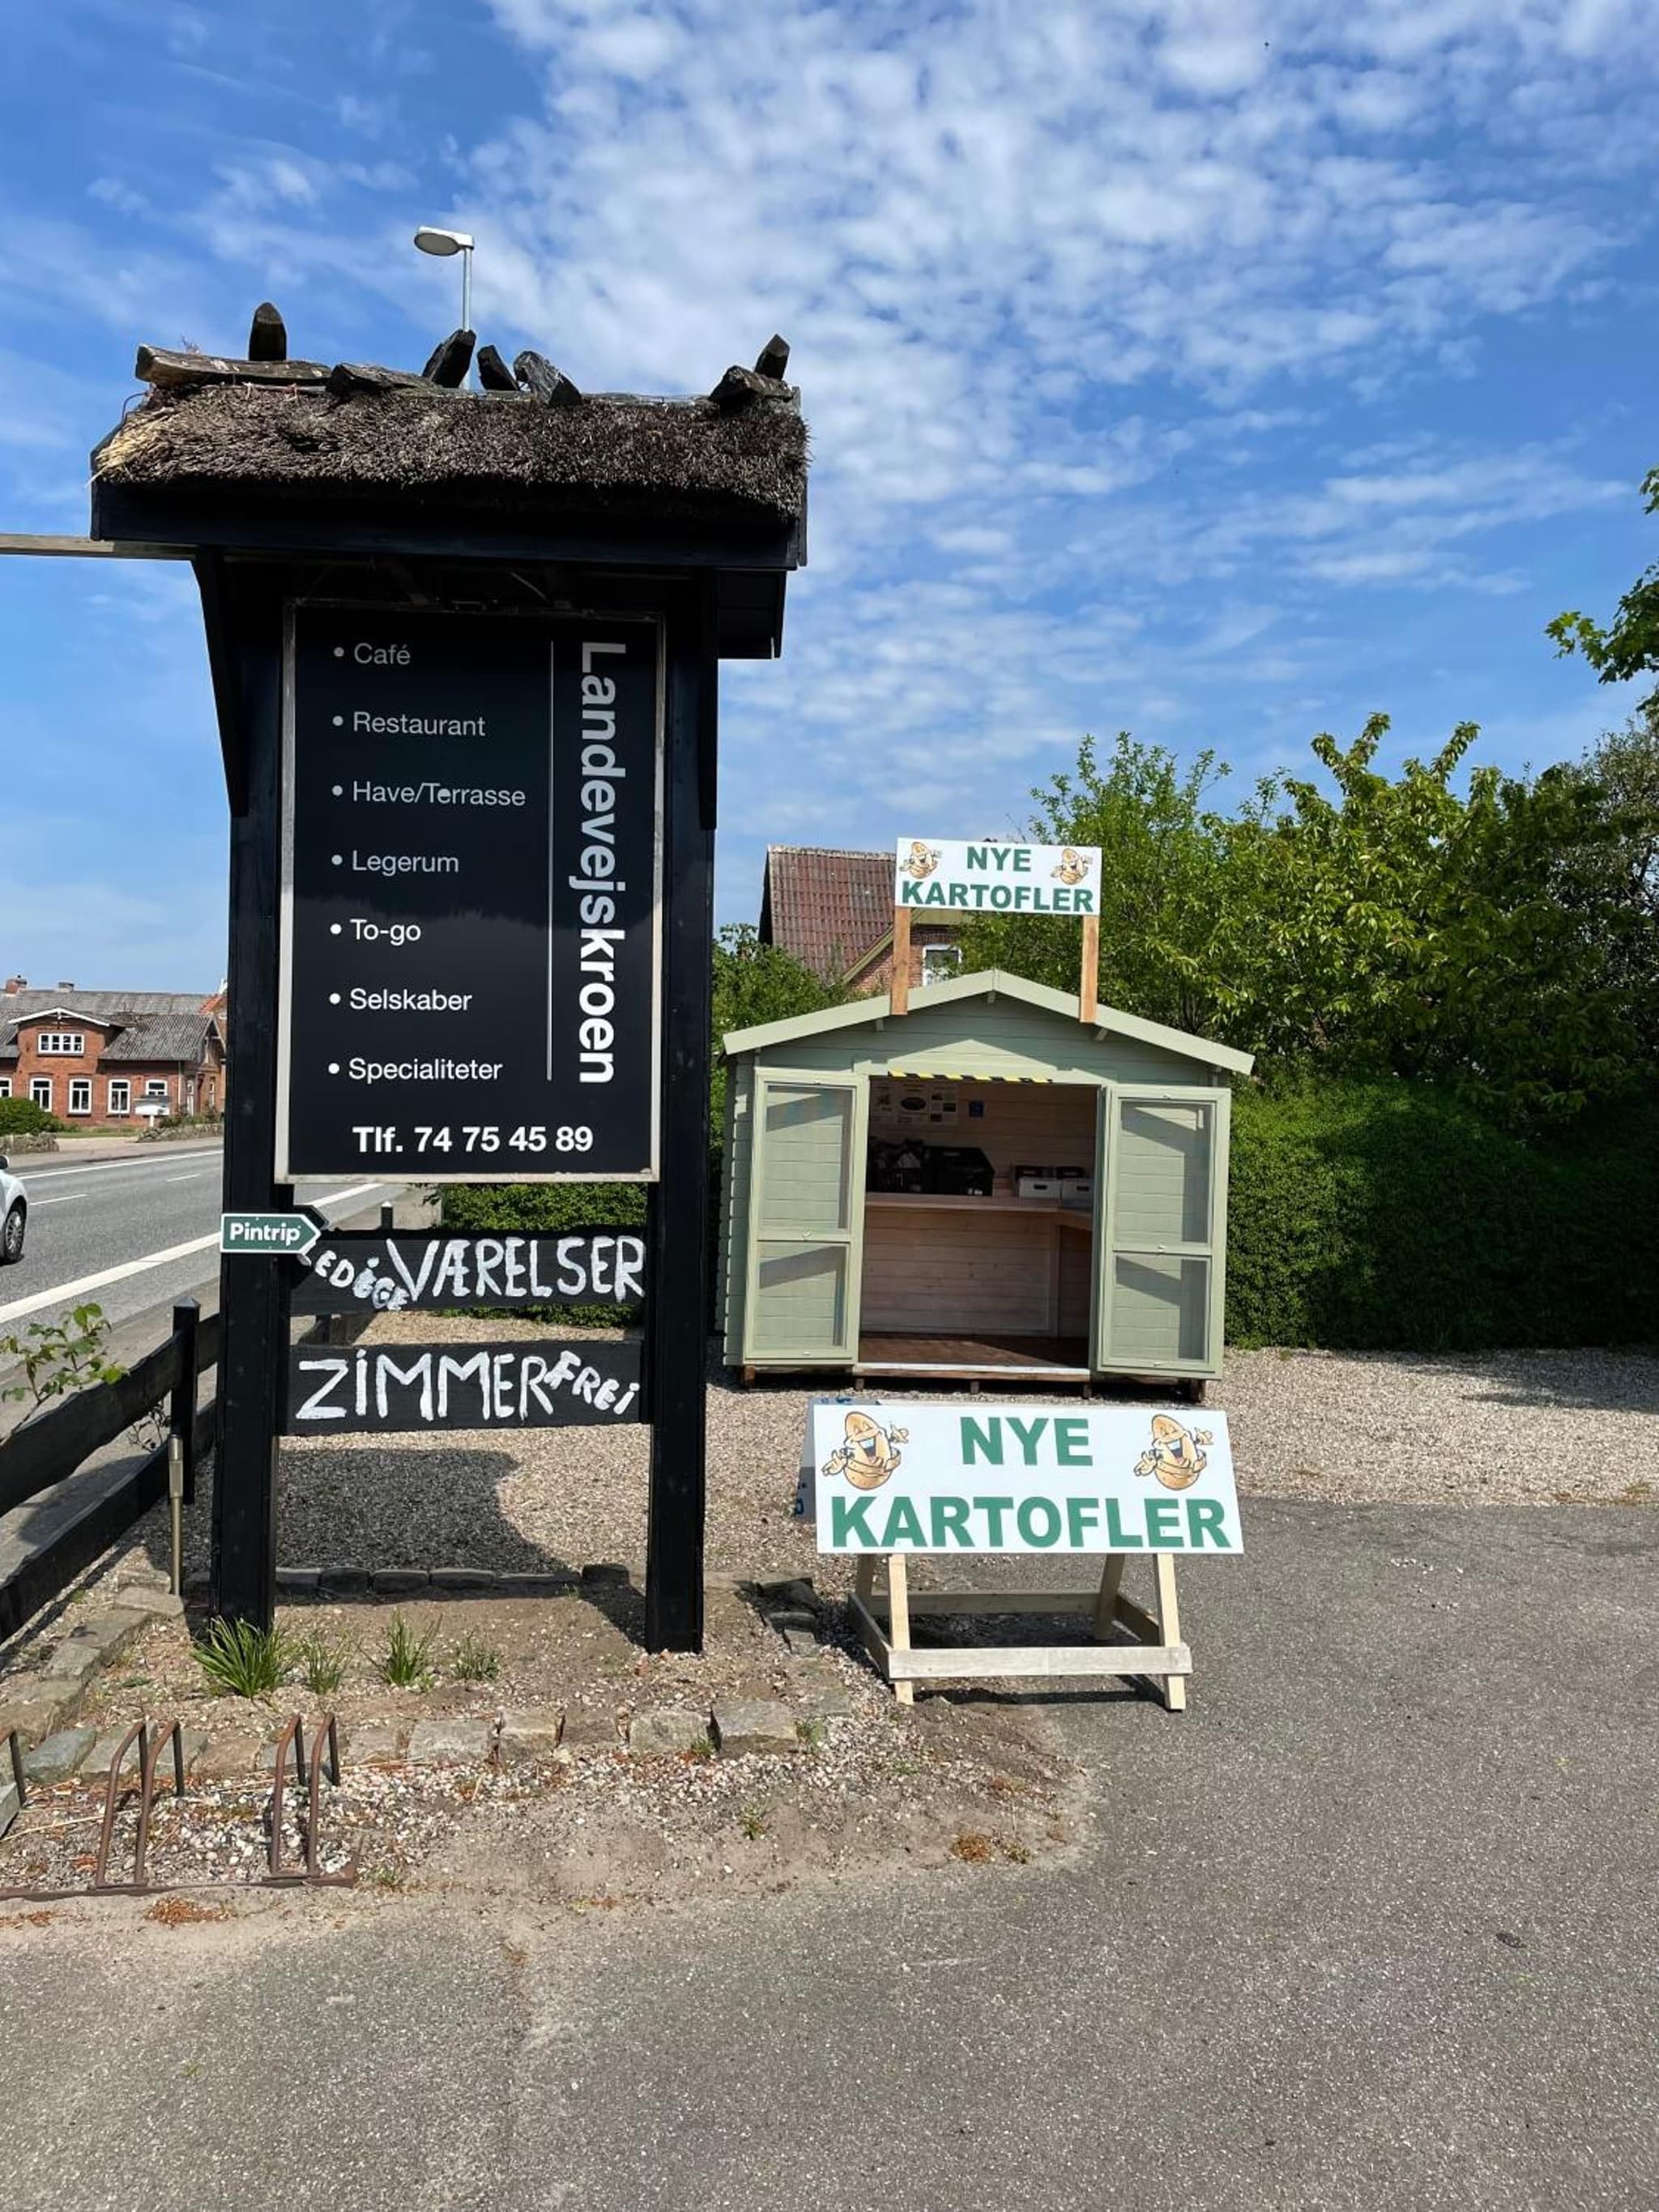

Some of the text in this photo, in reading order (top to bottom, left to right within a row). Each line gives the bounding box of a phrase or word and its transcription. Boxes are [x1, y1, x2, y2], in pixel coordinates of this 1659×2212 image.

[354, 643, 411, 665] Café
[353, 711, 486, 736] Restaurant
[353, 780, 526, 807] Have/Terrasse
[352, 850, 459, 877] Legerum
[569, 643, 626, 1084] Landevejskroen
[967, 846, 1031, 872] NYE
[902, 880, 1094, 912] KARTOFLER
[350, 918, 421, 946] To-go
[349, 987, 473, 1011] Selskaber
[348, 1057, 503, 1085] Specialiteter
[352, 1126, 594, 1153] Tlf. 74 75 45 89
[229, 1222, 301, 1247] Pintrip
[386, 1236, 646, 1302] VÆRELSER
[959, 1416, 1094, 1467] NYE
[831, 1496, 1232, 1548] KARTOFLER
